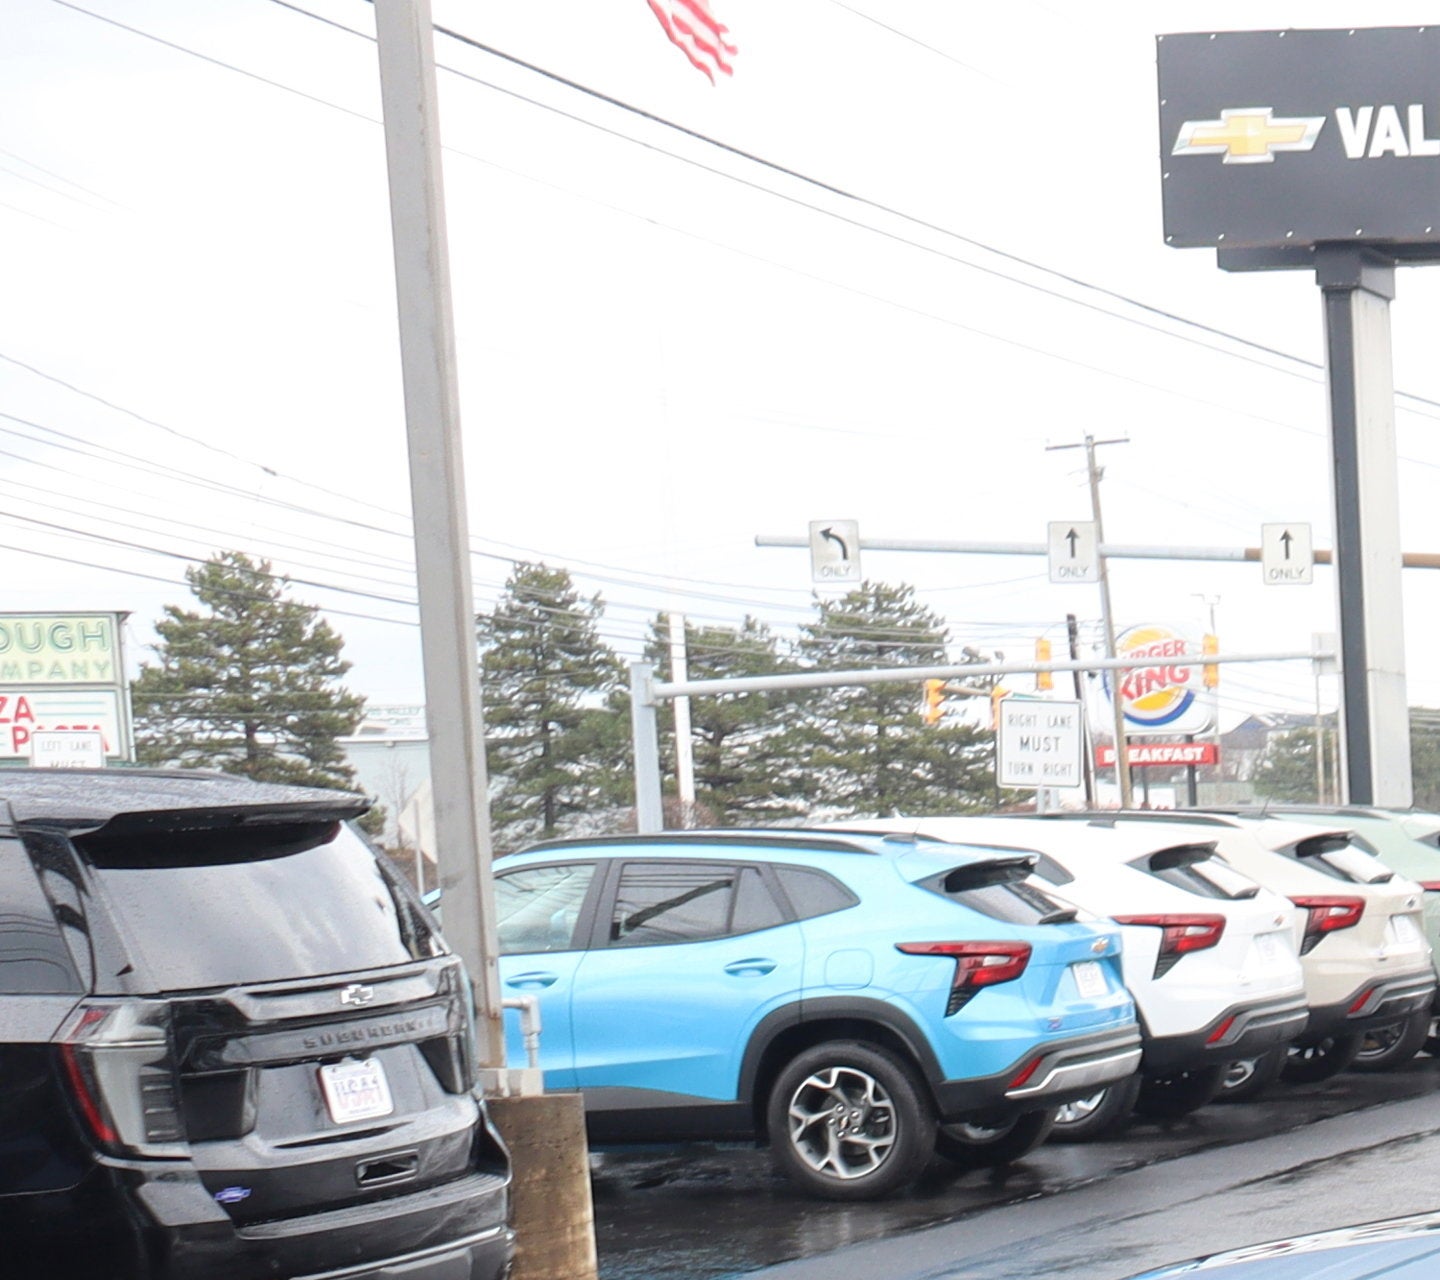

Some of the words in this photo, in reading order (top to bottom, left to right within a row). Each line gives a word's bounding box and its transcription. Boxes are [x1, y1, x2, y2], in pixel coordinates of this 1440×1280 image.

[821, 565, 851, 577] ONLY
[1058, 566, 1088, 578] ONLY
[1269, 567, 1305, 580] ONLY
[1008, 713, 1037, 727] RIGHT
[1047, 714, 1072, 729] LANE
[1019, 735, 1061, 752] MUST
[1104, 747, 1205, 763] BEAKFAST
[1008, 761, 1034, 775] TURN
[1043, 762, 1072, 777] RIGHT
